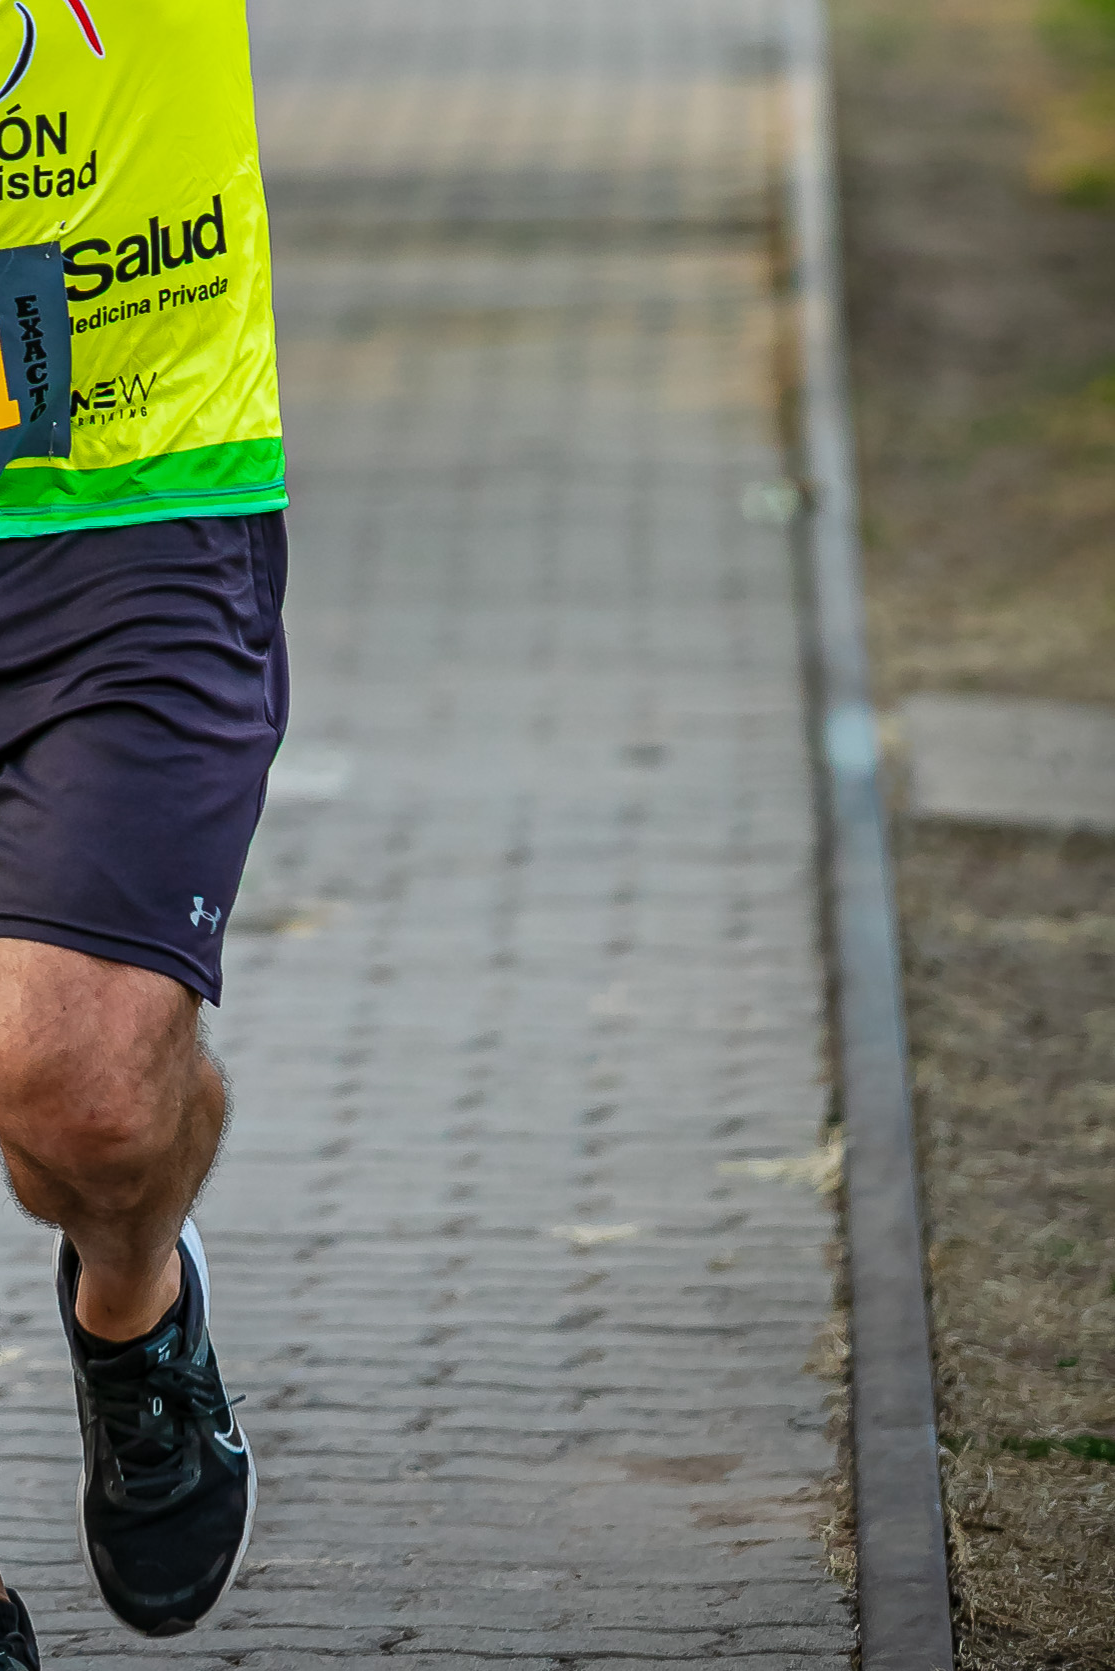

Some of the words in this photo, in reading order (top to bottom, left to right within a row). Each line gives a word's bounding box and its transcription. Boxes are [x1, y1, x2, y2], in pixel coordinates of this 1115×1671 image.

[62, 193, 227, 302] Salud
[158, 275, 228, 311] Privada
[14, 294, 49, 423] EXACTO
[70, 371, 157, 418] NEW
[70, 406, 148, 427] RAINING
